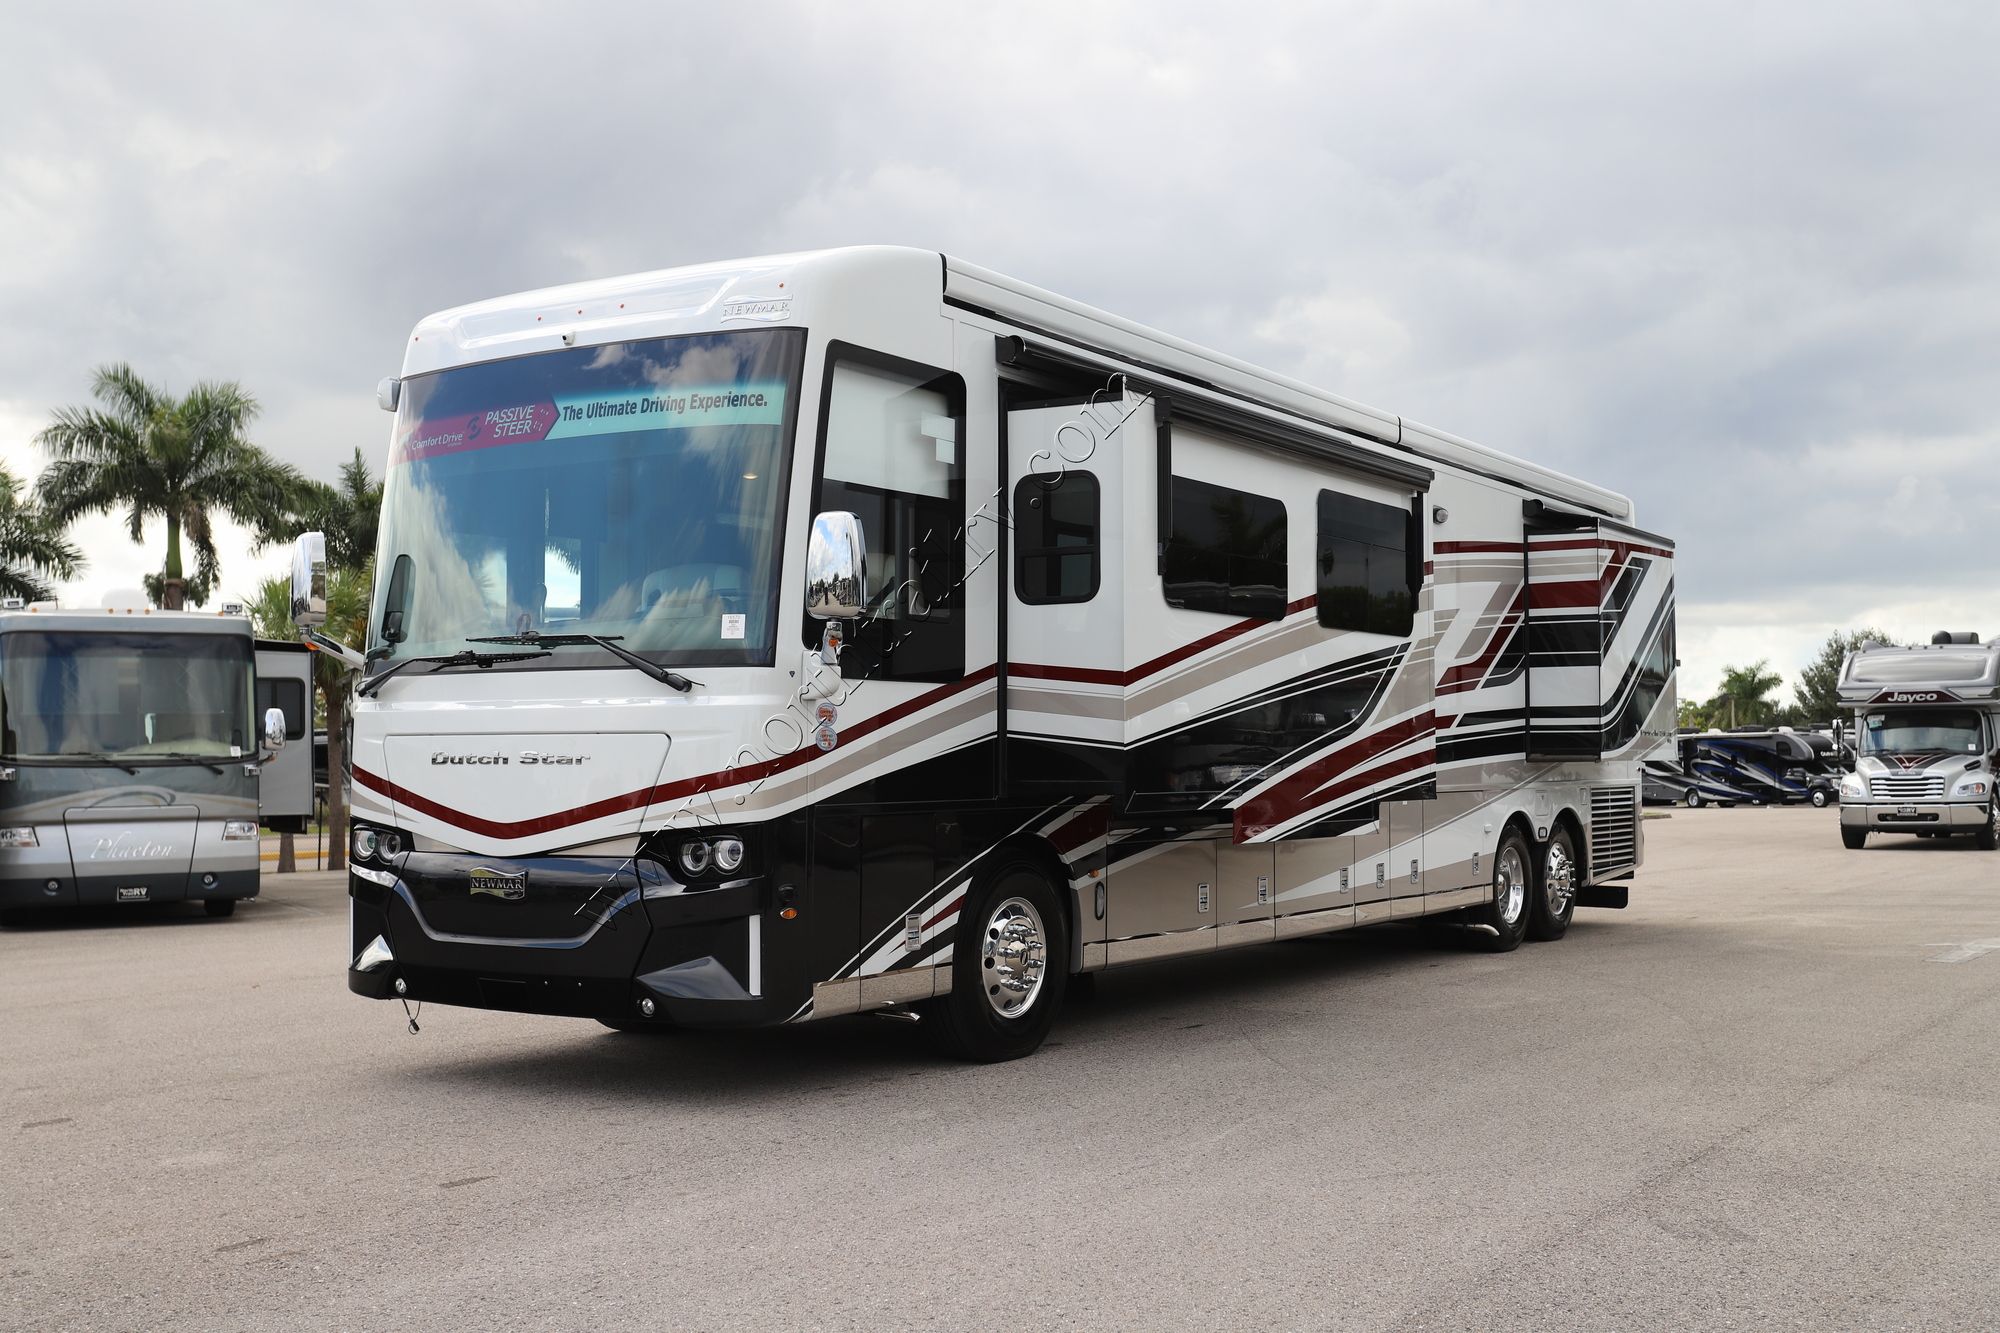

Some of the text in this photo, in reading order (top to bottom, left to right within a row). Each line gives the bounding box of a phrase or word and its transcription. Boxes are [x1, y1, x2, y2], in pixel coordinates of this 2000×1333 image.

[723, 302, 790, 317] NEWMAR
[563, 391, 768, 421] The Ultimate Driving Experience.
[485, 405, 535, 424] PASSIVE
[493, 420, 532, 438] STEER
[1887, 691, 1938, 703] Jayco
[431, 750, 591, 765] Dutch Star
[90, 830, 173, 859] Phaeton
[471, 878, 523, 889] NEWMAR
[133, 887, 148, 896] RV
